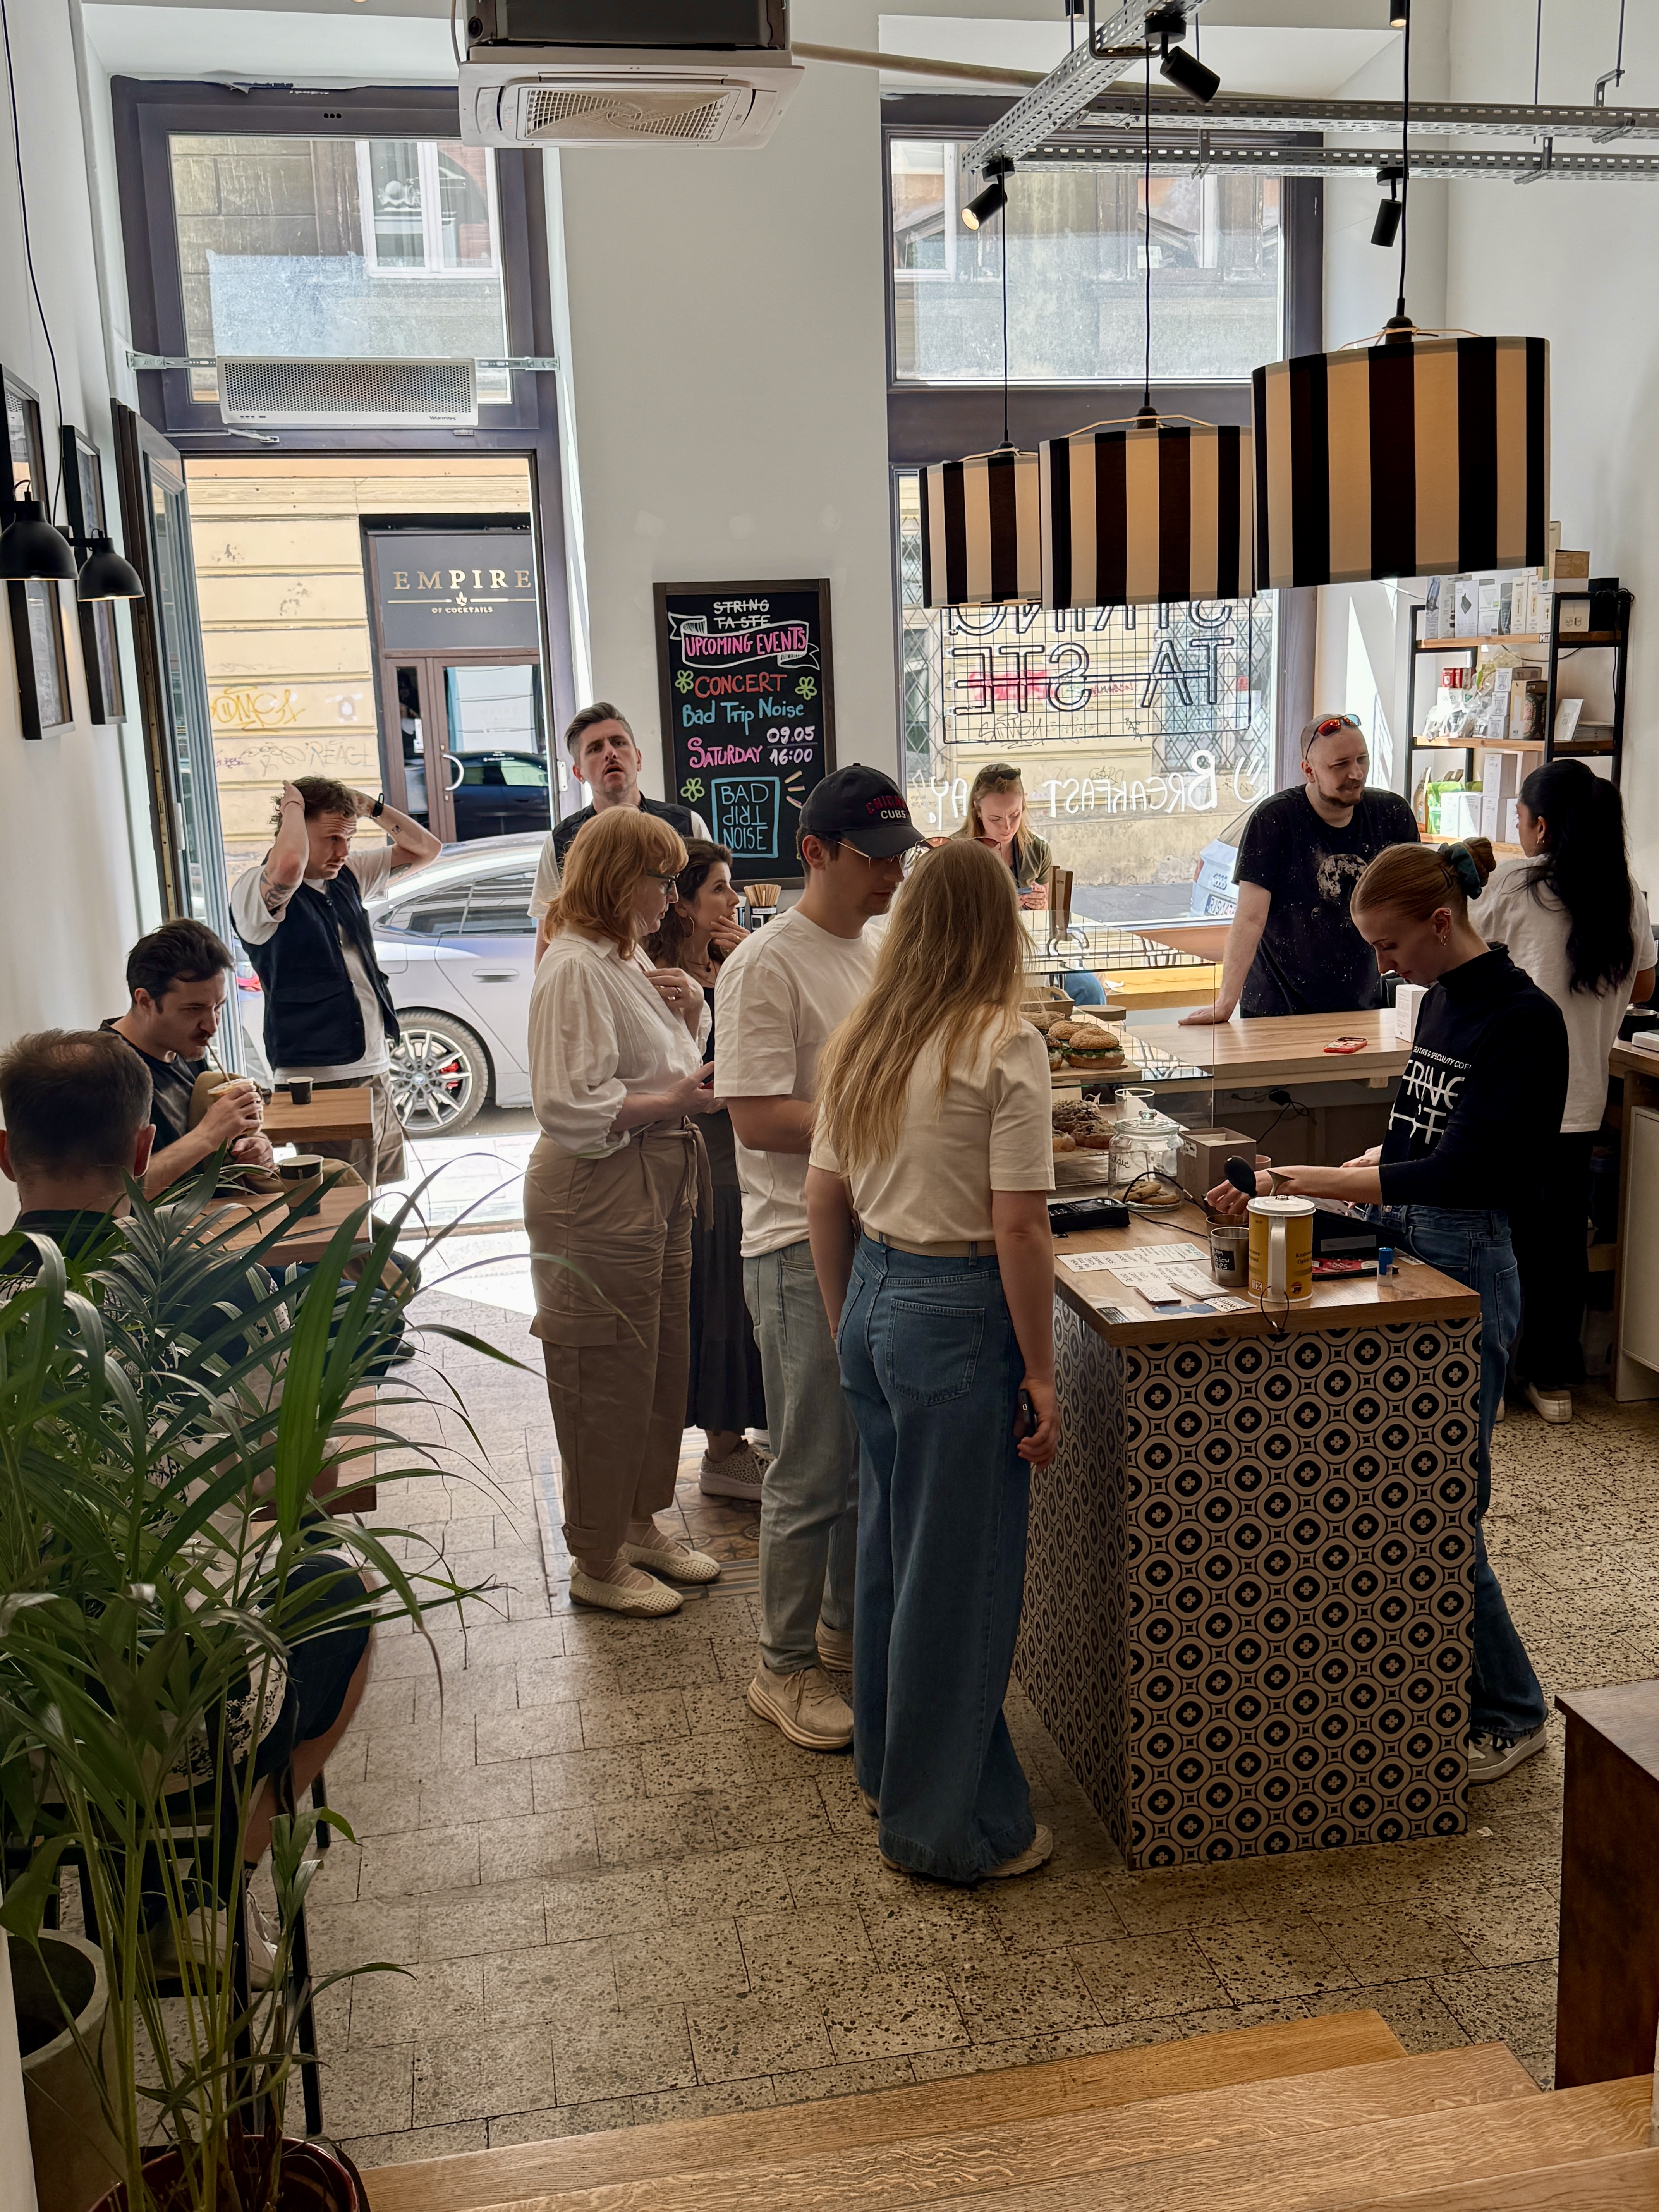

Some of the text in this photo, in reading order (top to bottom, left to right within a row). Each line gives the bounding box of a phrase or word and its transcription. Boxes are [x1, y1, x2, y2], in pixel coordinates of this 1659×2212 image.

[392, 569, 531, 590] EMPIRE
[713, 599, 770, 615] STRING
[685, 626, 807, 657] UPCOMING EVENTS
[694, 674, 787, 699] CONCERT
[682, 697, 804, 735] Bad Trip Noise
[687, 726, 816, 768] SATURDAY 09.05
[769, 749, 814, 766] 16:00
[721, 783, 769, 805] BAD
[722, 805, 767, 826] TRIP
[880, 809, 906, 819] CUBS
[722, 826, 767, 850] NOISE
